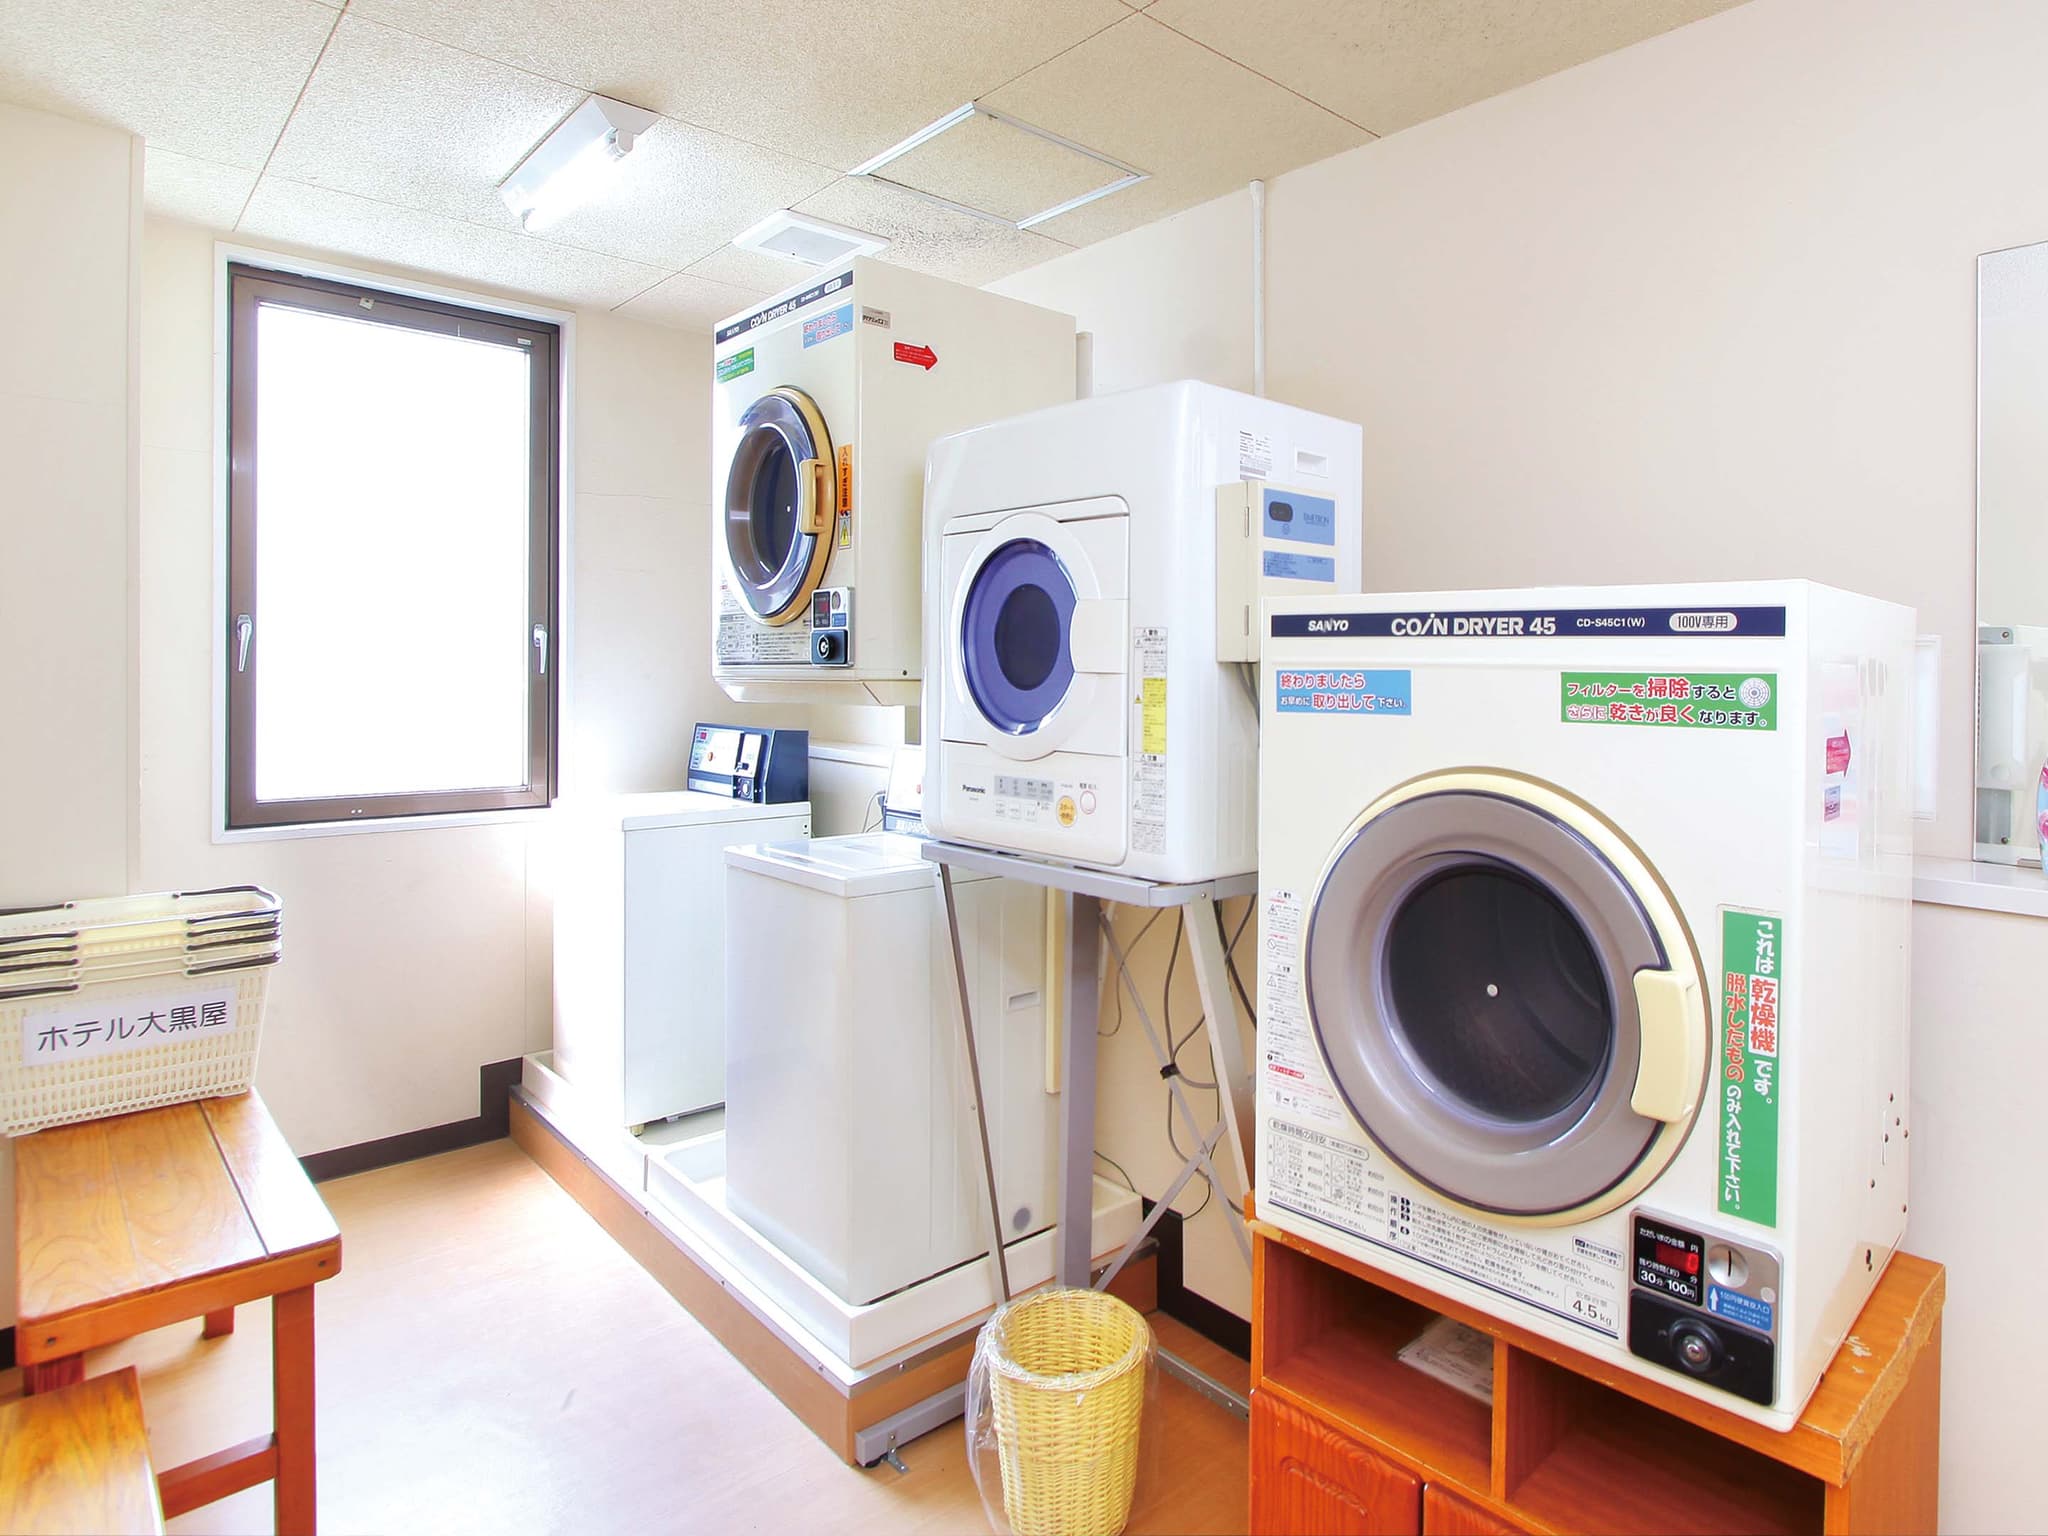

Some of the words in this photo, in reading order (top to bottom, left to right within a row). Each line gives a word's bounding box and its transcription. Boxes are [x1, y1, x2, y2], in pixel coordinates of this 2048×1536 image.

[1308, 619, 1349, 632] SANYO
[1391, 613, 1448, 636] COIN
[1453, 616, 1524, 635] DRYER
[1529, 616, 1556, 635] 45
[1576, 616, 1645, 628] CD-S45C1(W)
[1677, 615, 1728, 629] 100V専用
[1280, 673, 1365, 690] 終わりましたら
[1567, 678, 1736, 699] フィルターを掃除すると
[38, 1000, 228, 1052] ホテル大黒屋
